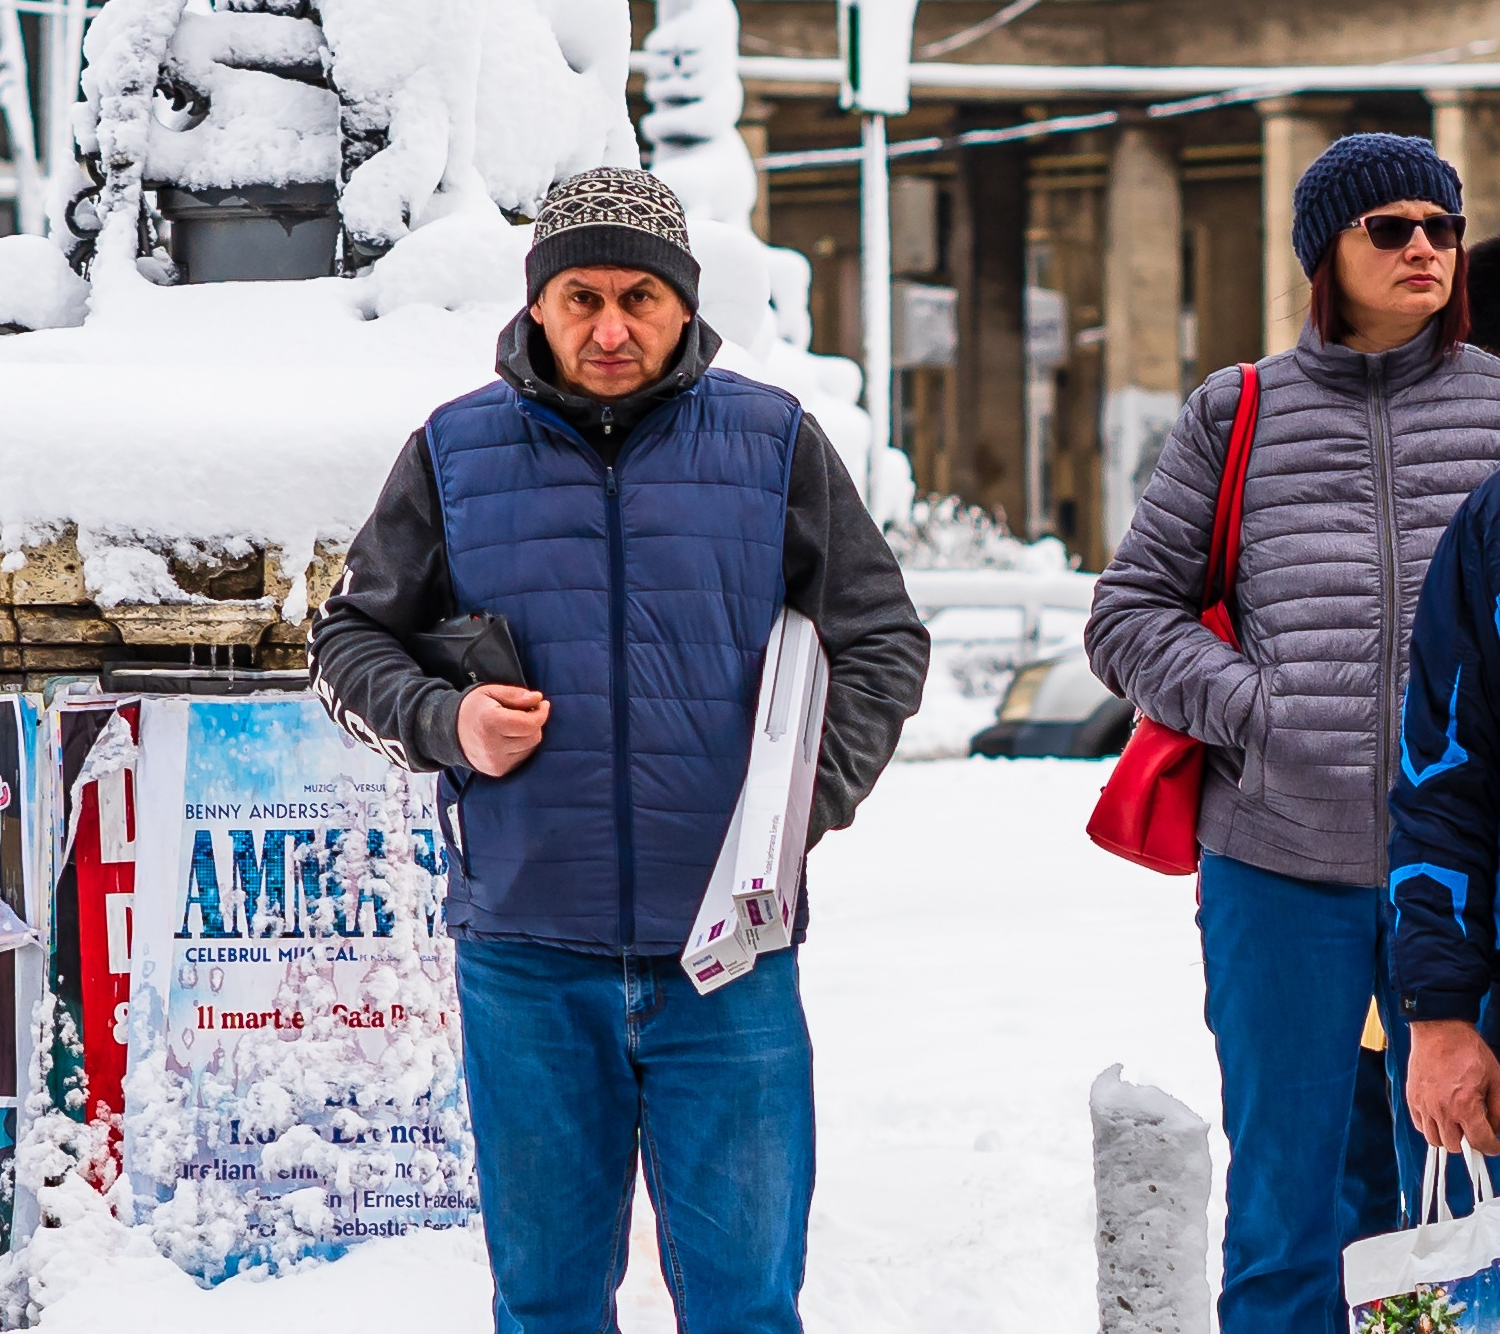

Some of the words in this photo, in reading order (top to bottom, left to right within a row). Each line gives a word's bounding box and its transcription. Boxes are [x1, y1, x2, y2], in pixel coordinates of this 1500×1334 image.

[185, 804, 241, 820] BENNY
[250, 803, 358, 819] ANDERSS
[185, 947, 272, 963] CELEBRUL
[279, 947, 359, 963] MUCAL
[363, 1191, 420, 1208] Ernest
